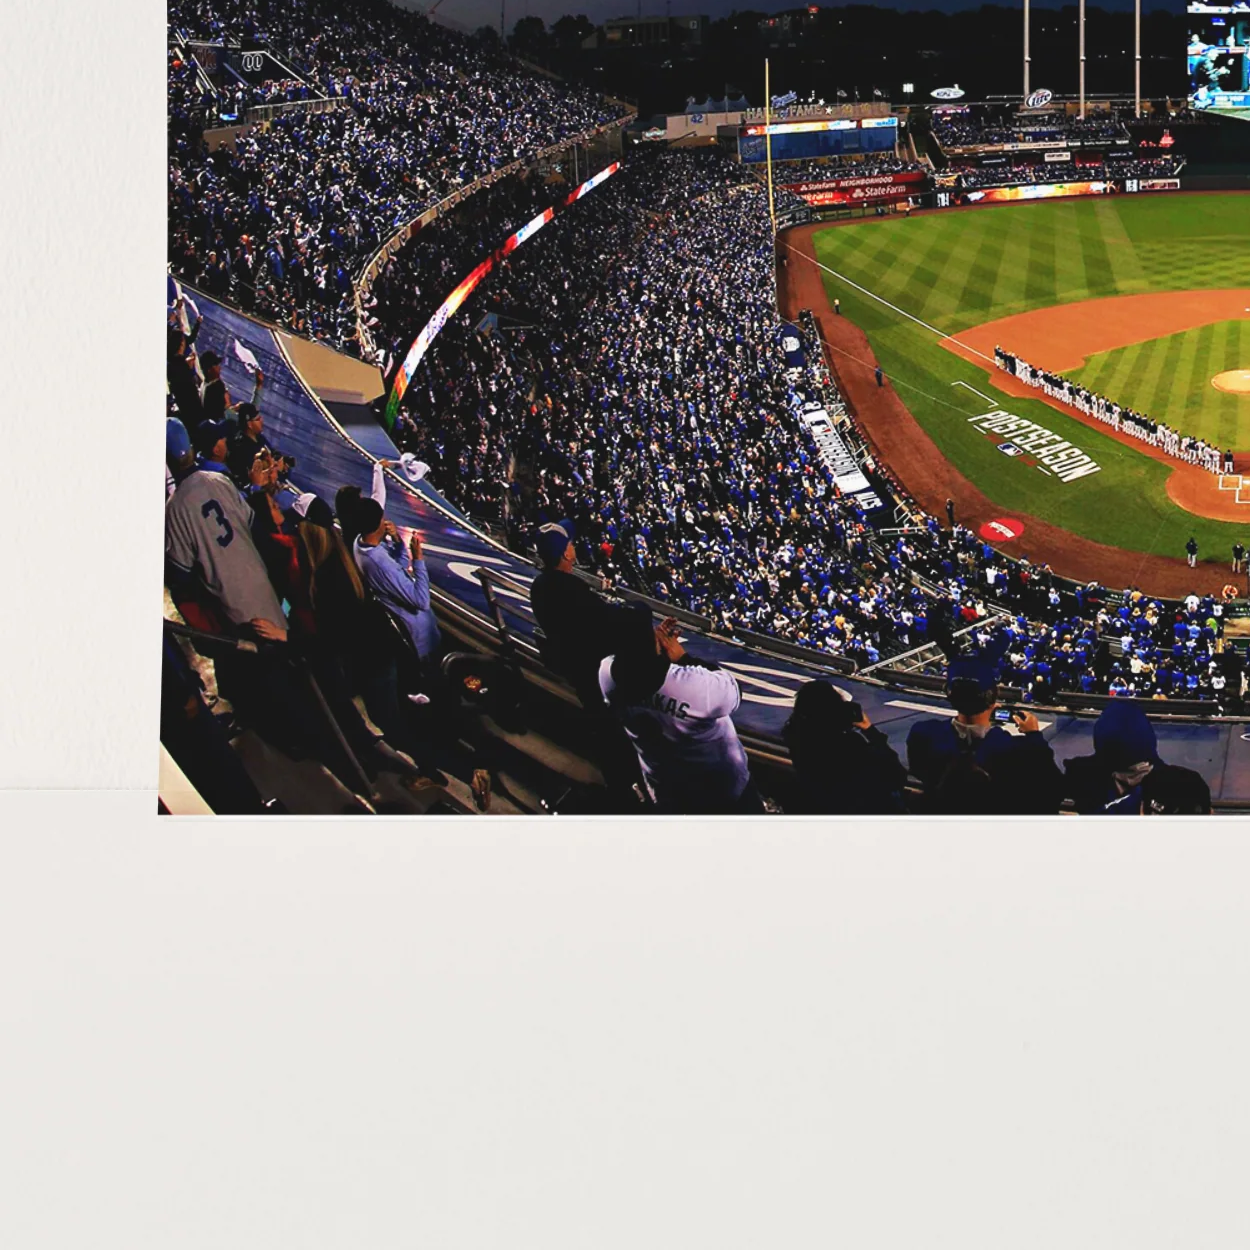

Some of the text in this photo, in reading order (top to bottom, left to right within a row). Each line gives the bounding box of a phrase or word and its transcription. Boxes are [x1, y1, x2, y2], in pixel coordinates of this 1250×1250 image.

[789, 104, 823, 117] FAME
[967, 409, 1102, 483] POSTSEASON
[202, 499, 234, 548] 3
